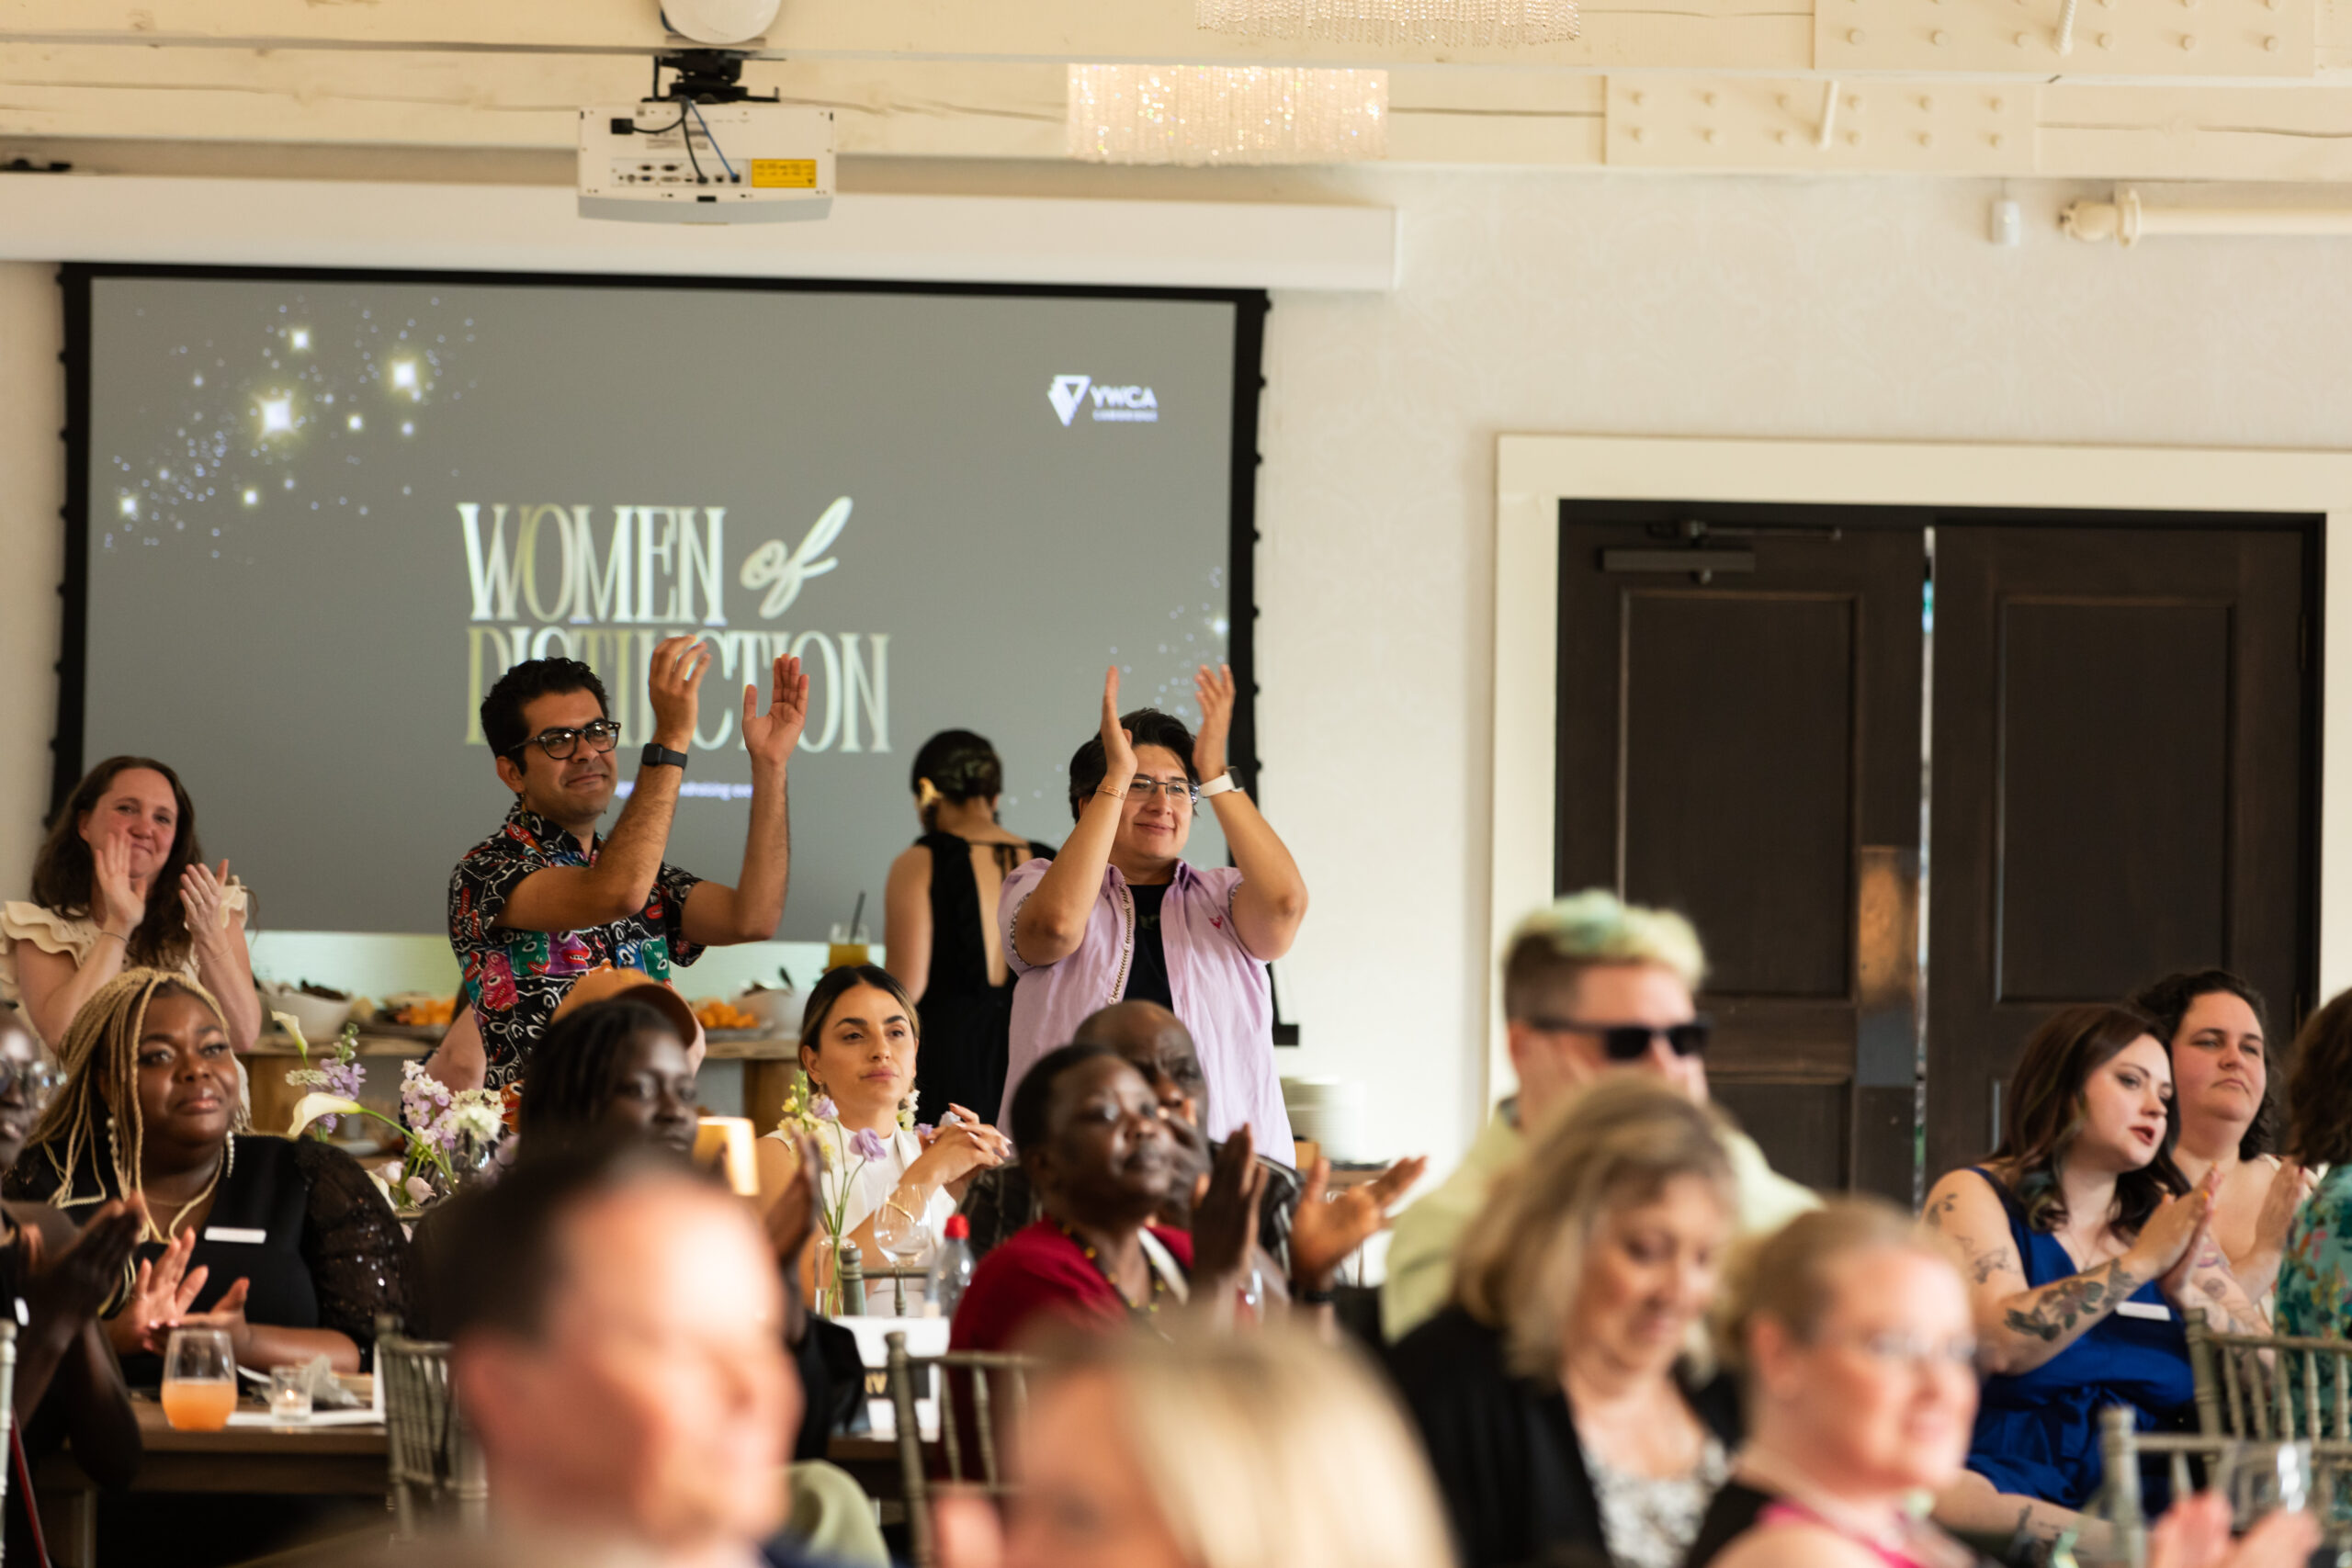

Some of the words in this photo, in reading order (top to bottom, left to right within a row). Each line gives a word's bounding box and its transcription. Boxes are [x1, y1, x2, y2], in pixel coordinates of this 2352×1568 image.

[1090, 385, 1158, 408] YWCA
[456, 502, 728, 625] WOMEN
[740, 496, 854, 620] of
